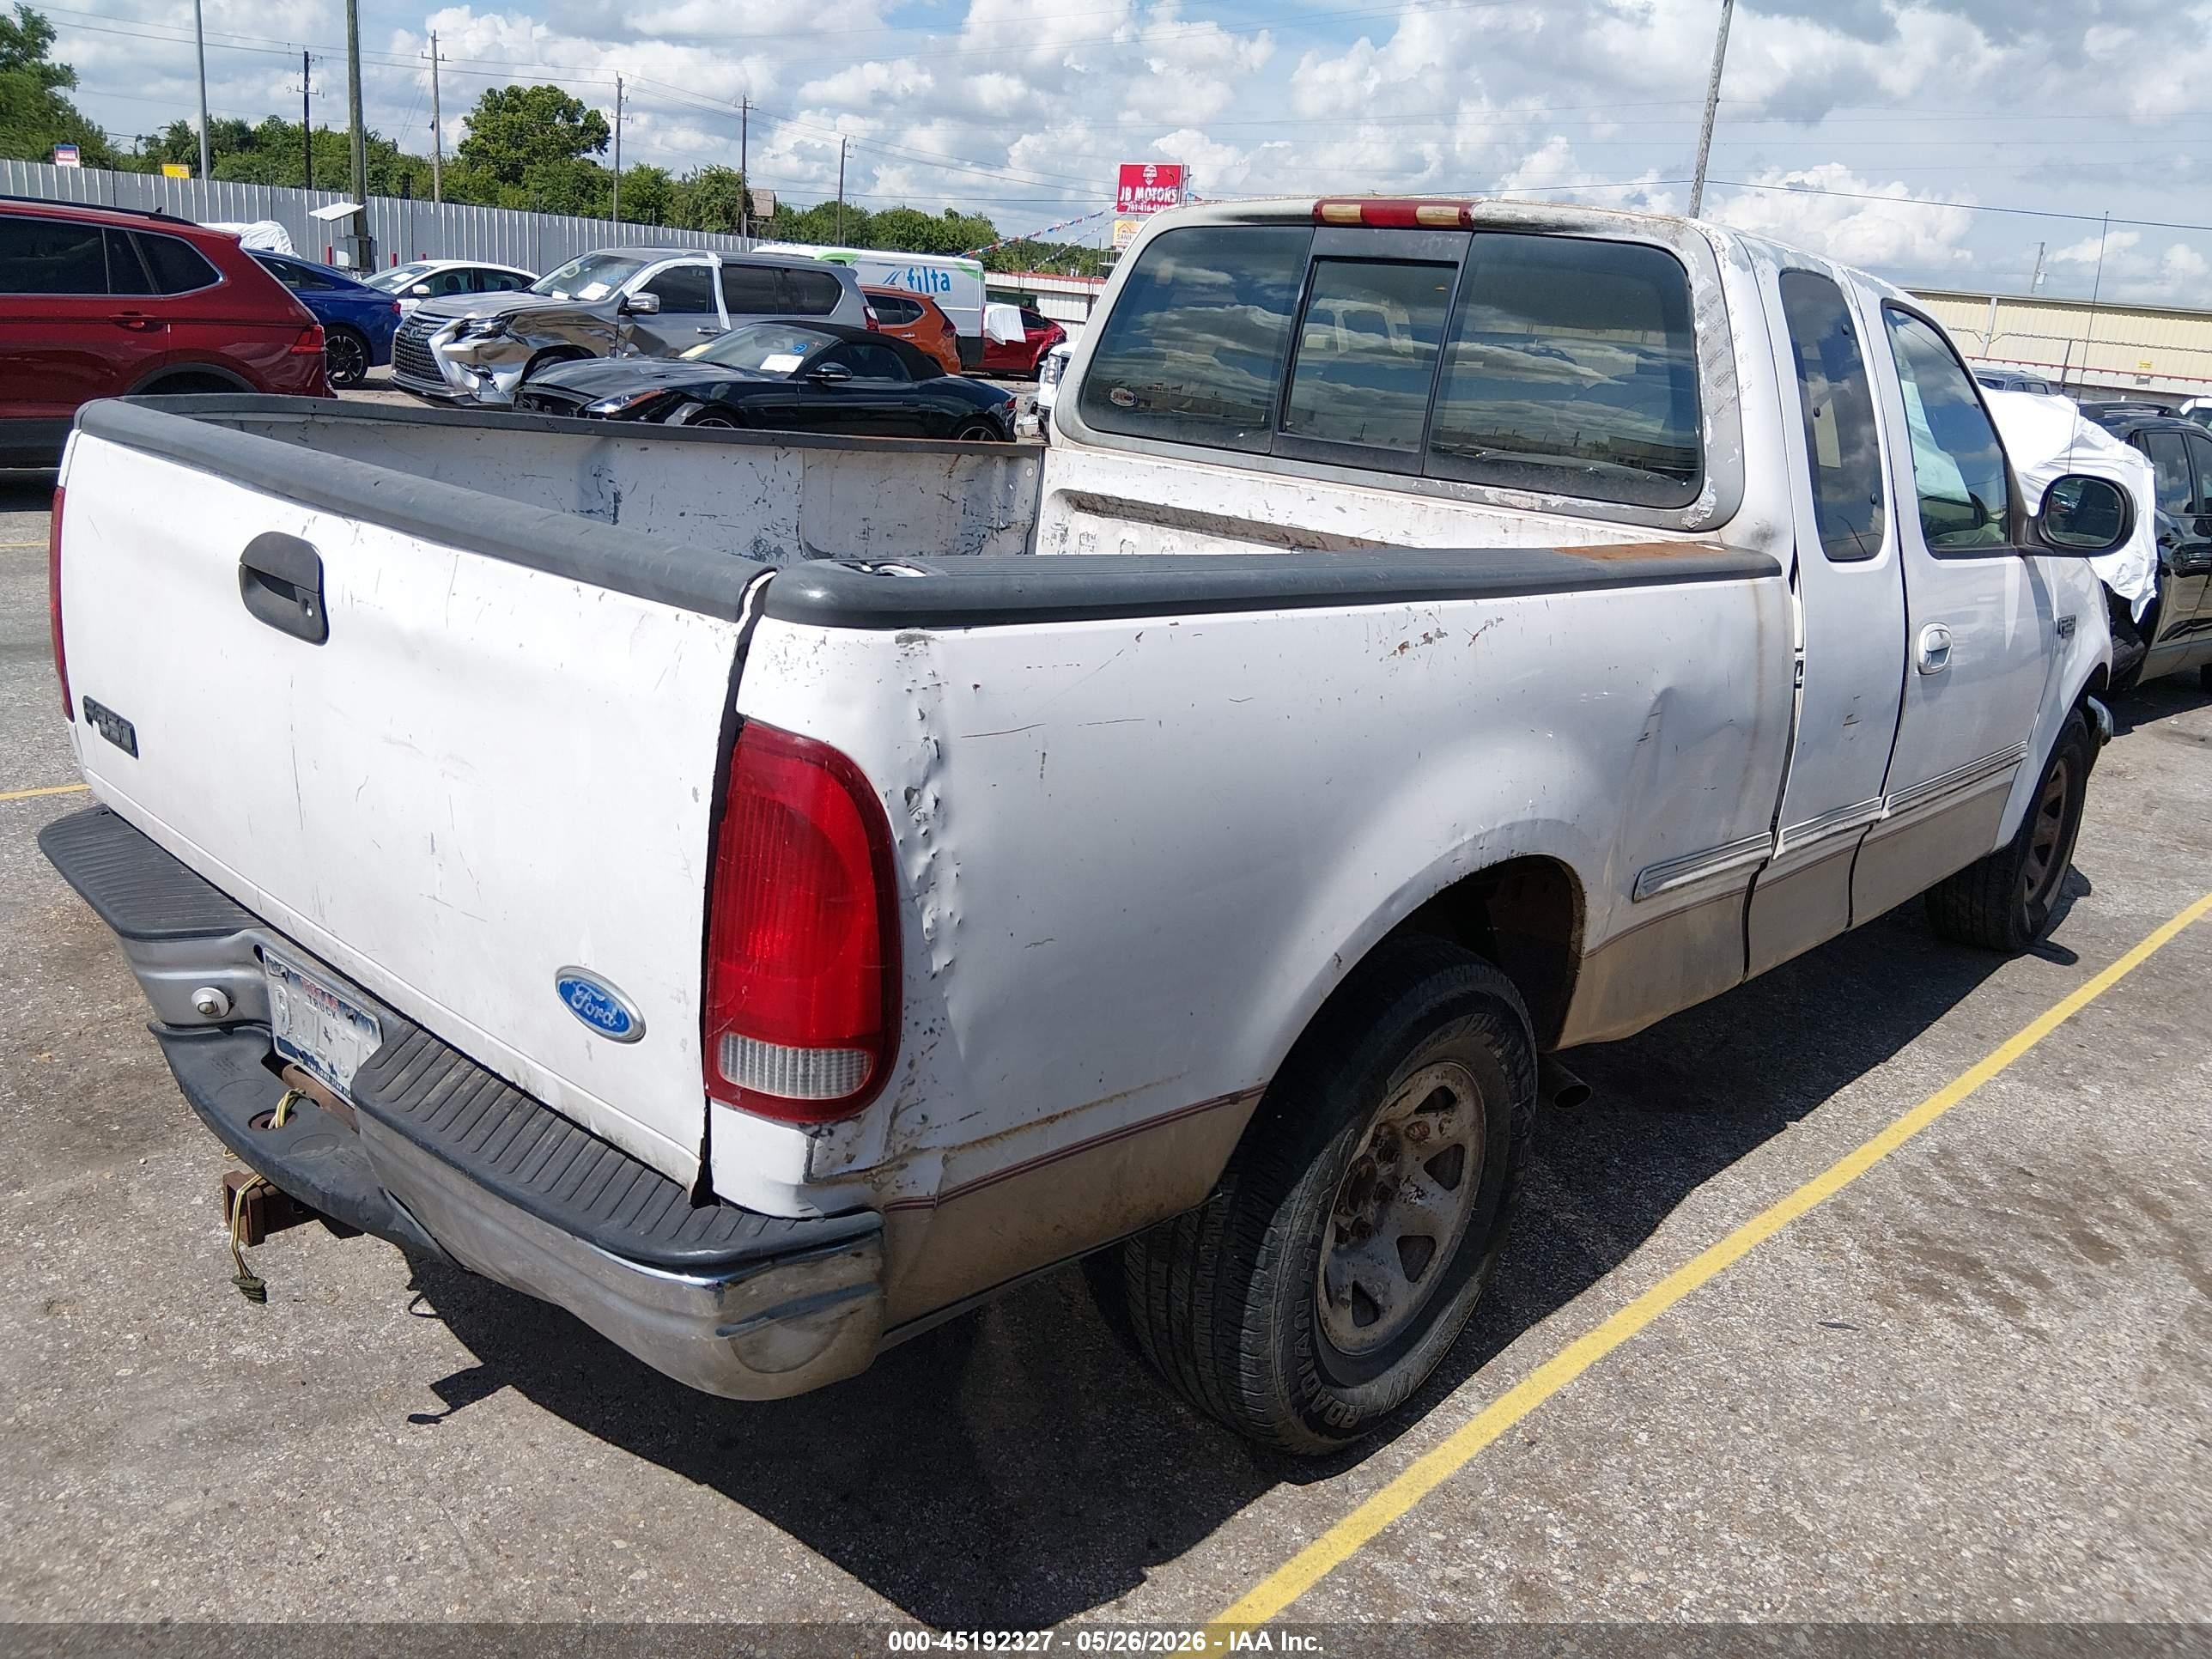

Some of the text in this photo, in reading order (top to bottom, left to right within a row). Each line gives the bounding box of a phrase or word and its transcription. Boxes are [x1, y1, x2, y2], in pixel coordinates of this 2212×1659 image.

[1120, 185, 1177, 204] JB MOTORS
[907, 266, 951, 293] filta
[307, 994, 338, 1021] TRUCK
[570, 983, 623, 1027] Ford
[307, 1061, 317, 1072] THE
[317, 1067, 330, 1081] LONE
[331, 1079, 343, 1091] STAR
[1293, 1298, 1365, 1429] ROADIAN
